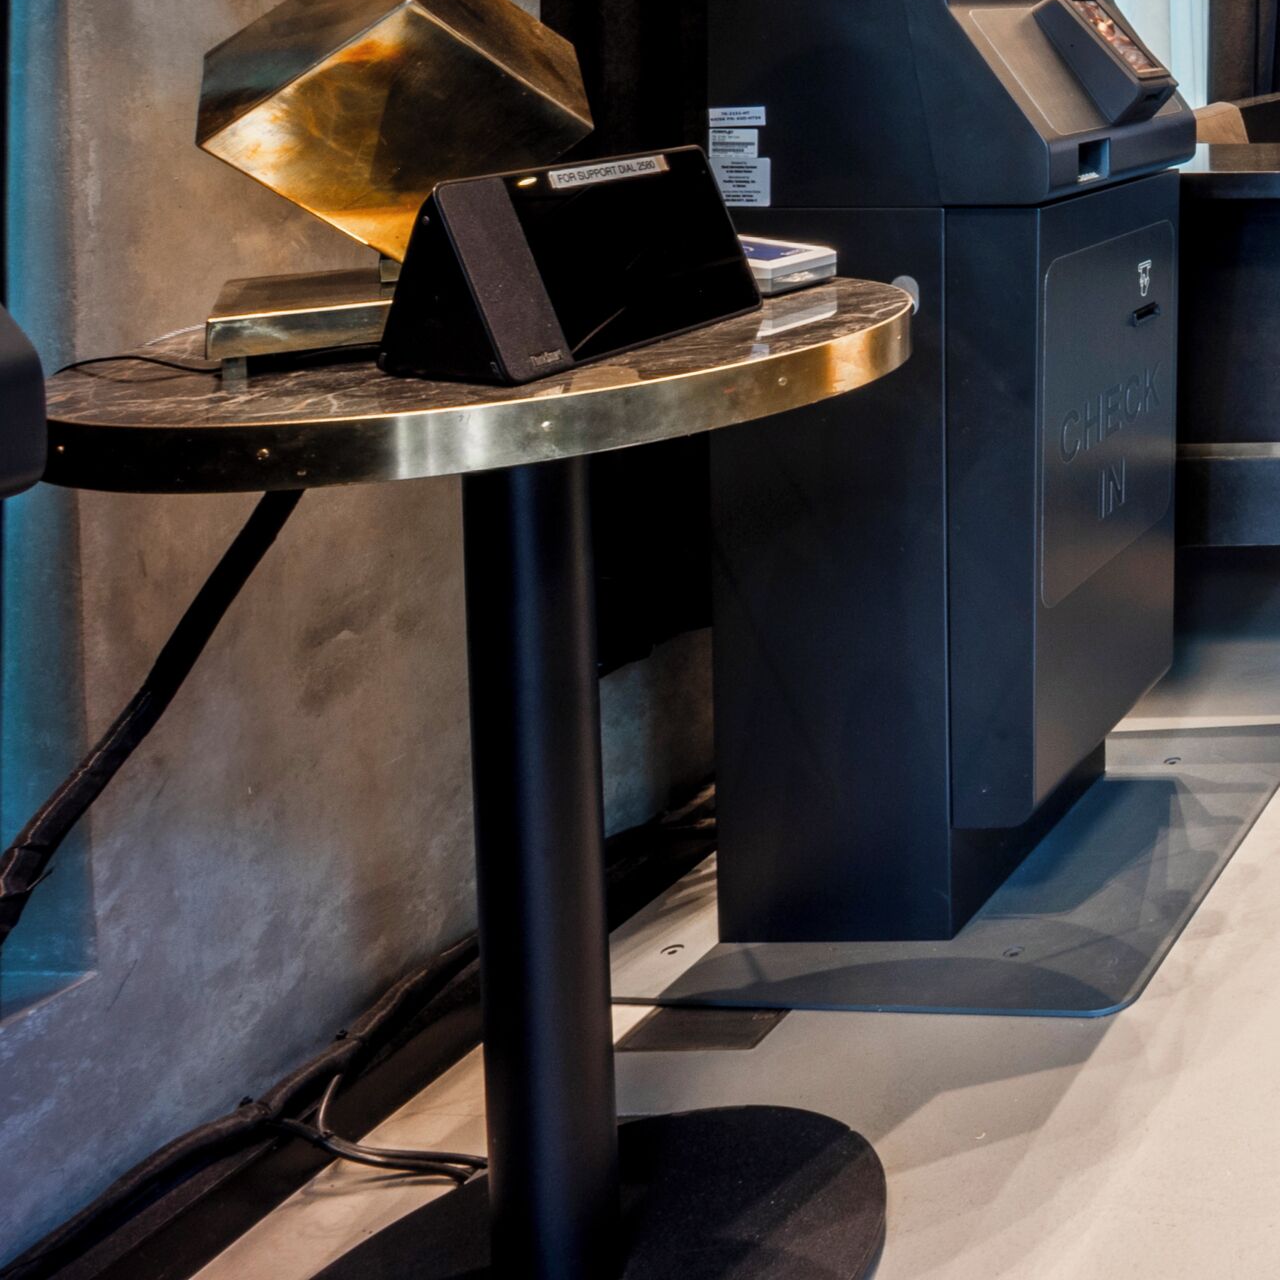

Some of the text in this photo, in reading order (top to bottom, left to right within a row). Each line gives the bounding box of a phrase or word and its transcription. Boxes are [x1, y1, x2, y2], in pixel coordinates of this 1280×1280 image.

[557, 173, 576, 183] FOR
[576, 166, 617, 180] SUPPORT
[618, 163, 636, 174] DIAL
[1058, 360, 1162, 464] CHECK
[1099, 456, 1127, 521] IN
